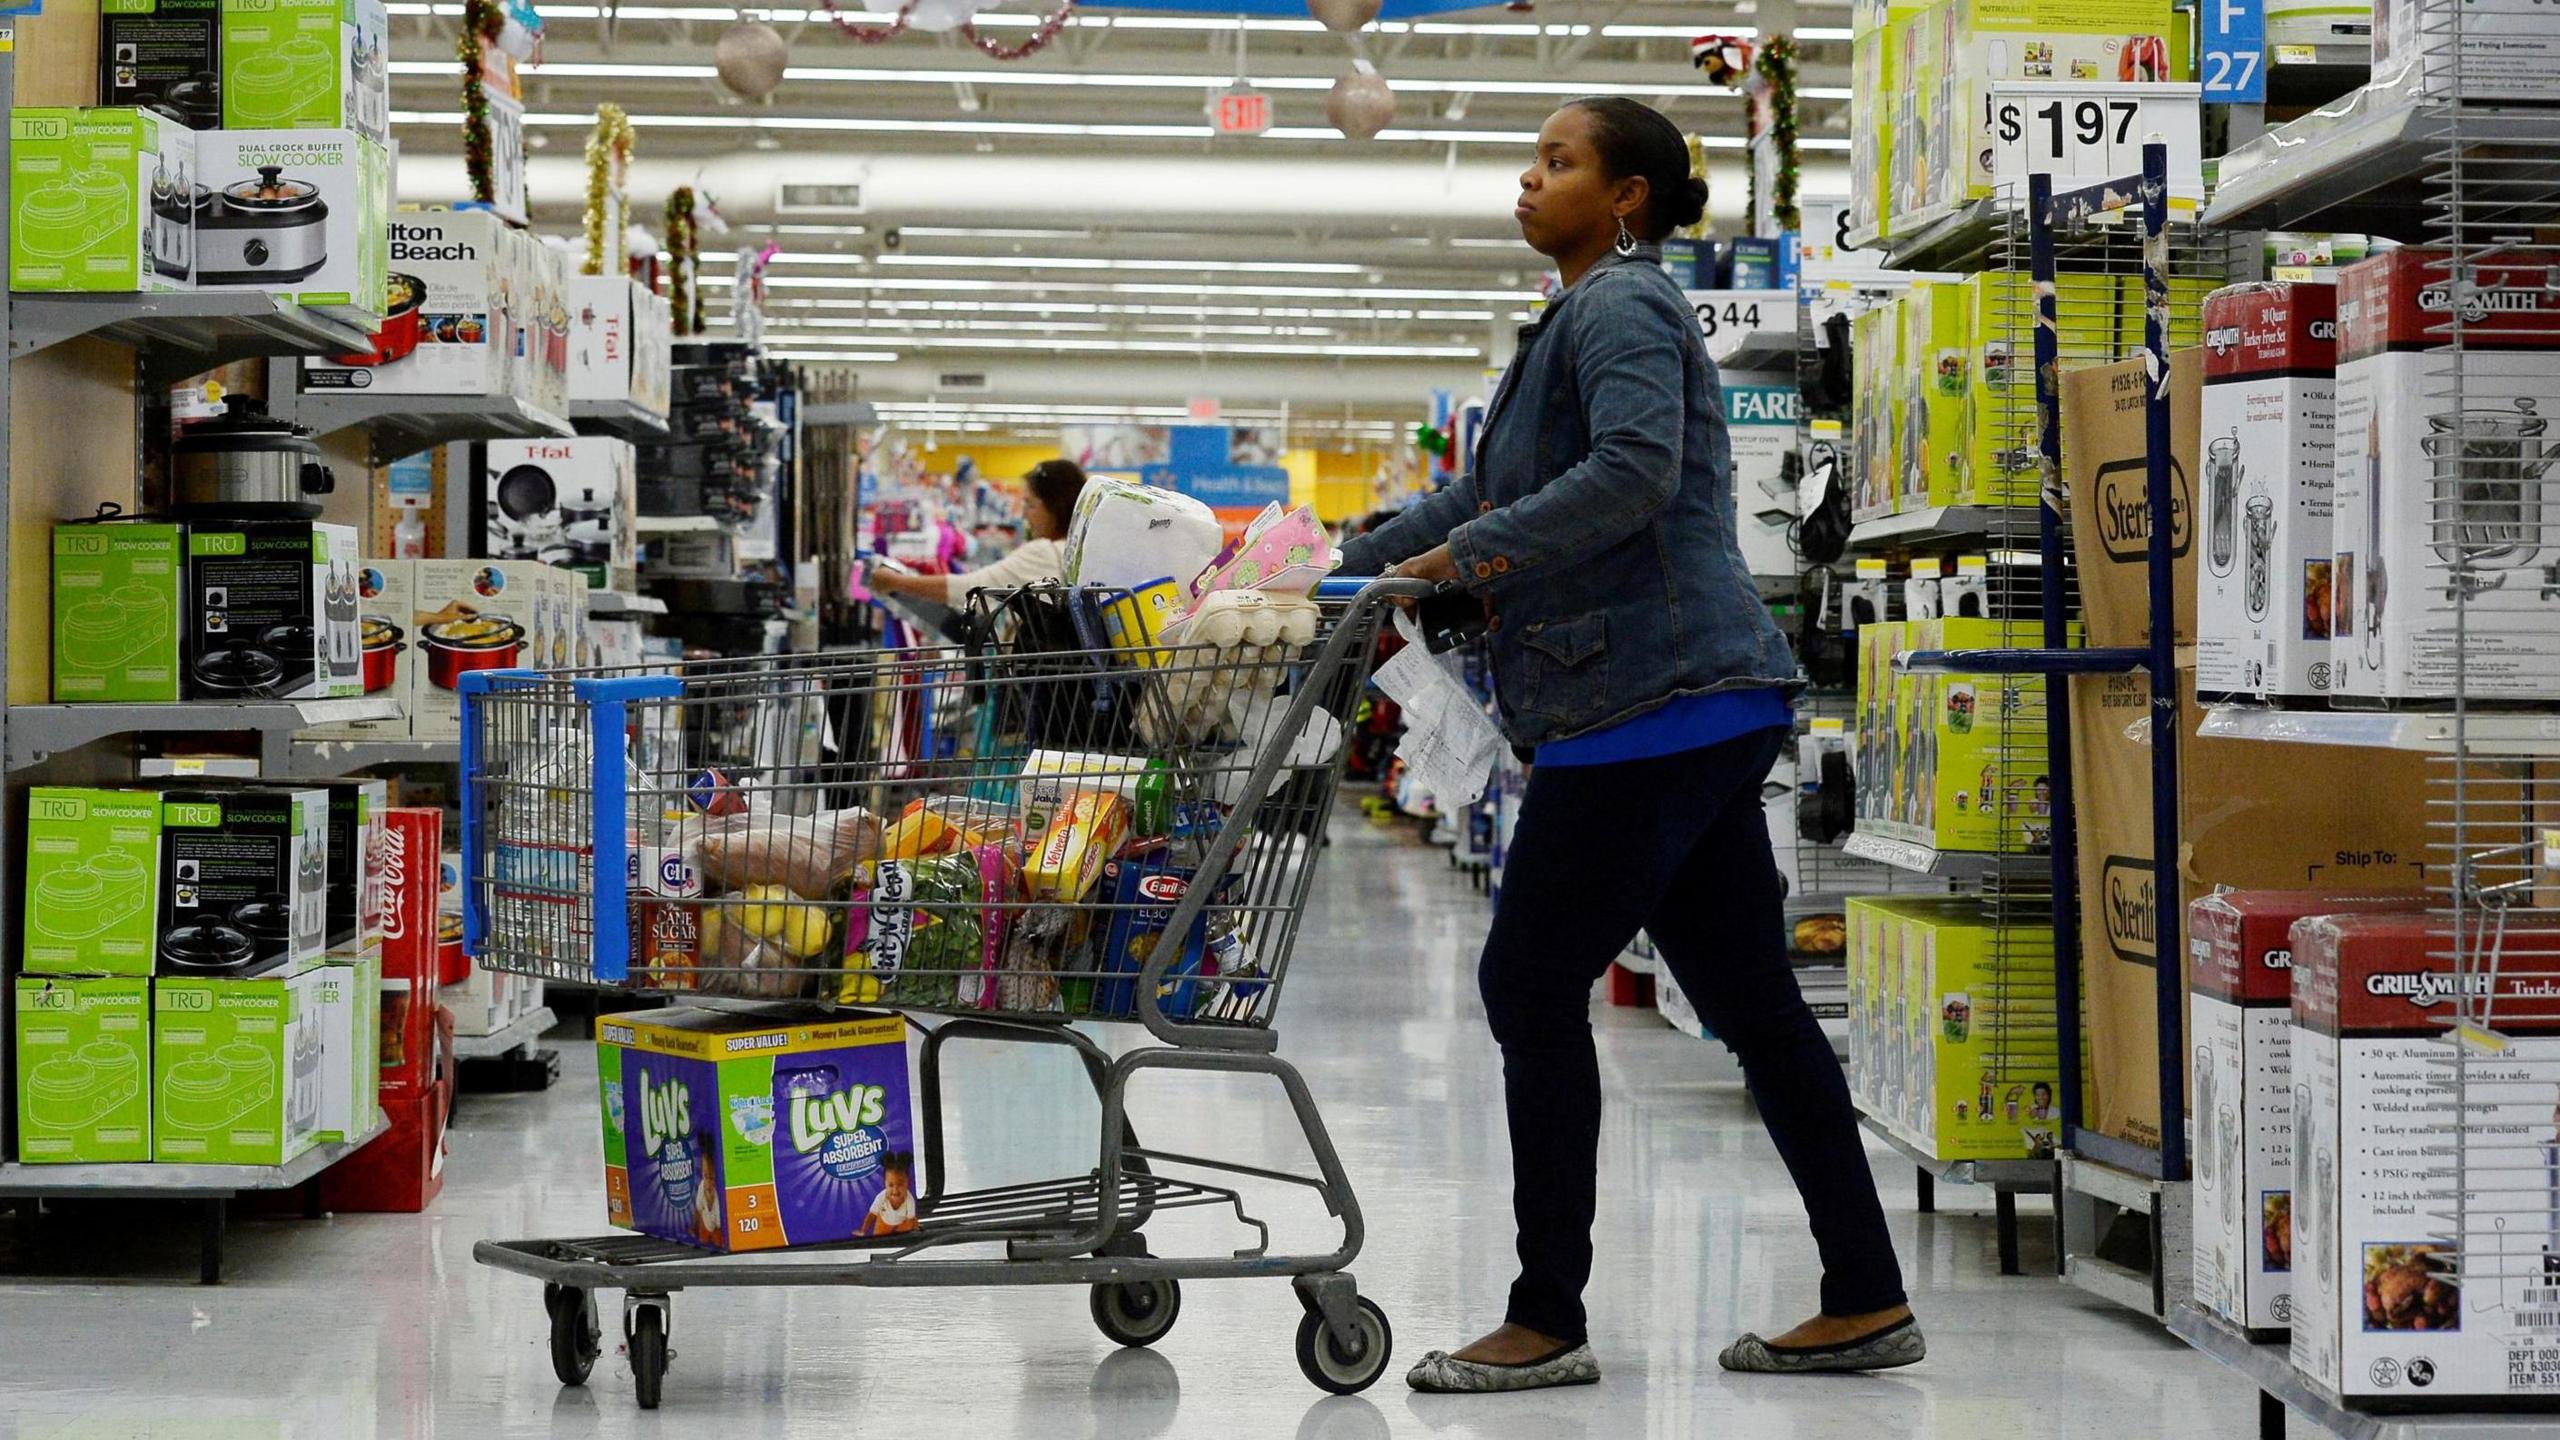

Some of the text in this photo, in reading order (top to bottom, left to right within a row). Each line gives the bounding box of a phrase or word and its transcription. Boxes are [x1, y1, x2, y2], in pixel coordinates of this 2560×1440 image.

[2204, 51, 2261, 92] 27
[1220, 96, 1263, 130] EXIT
[1999, 102, 2022, 146] $
[238, 143, 343, 152] DUAL CROCK BUFFET
[238, 152, 344, 167] SLOW COOKER
[390, 242, 476, 260] Beach
[2418, 289, 2538, 318] GRMITH
[525, 446, 573, 459] T-fal
[2106, 482, 2183, 542] Sterie
[1149, 518, 1173, 529] Bounty
[1034, 794, 1062, 803] Value
[92, 807, 153, 819] SLOW COOKER
[226, 814, 287, 824] SLOW COOKER
[1045, 824, 1070, 867] Velveeta
[2335, 851, 2398, 868] Ship To:
[383, 825, 405, 940] CocaCola
[873, 861, 903, 916] Clean
[1149, 878, 1187, 894] Barila
[656, 910, 693, 927] CANE
[1139, 907, 1172, 919] ELBO
[651, 923, 697, 940] SUGAR
[2366, 970, 2491, 1001] GRILLSMH
[80, 995, 142, 1006] SLOW COOKER
[218, 998, 280, 1009] SLOW COOKER
[2267, 1017, 2279, 1026] 30
[812, 1029, 838, 1041] Money
[839, 1027, 856, 1038] Back
[726, 1033, 788, 1051] SUPER VALUE!
[2269, 1038, 2291, 1046] Auto
[2269, 1050, 2291, 1059] cook
[2371, 1049, 2455, 1061] 30 qt. Aluminum
[2502, 1048, 2516, 1058] lid
[2372, 1070, 2423, 1081] Automatic
[2425, 1070, 2452, 1081] timer
[2457, 1070, 2497, 1082] rovides
[2507, 1069, 2531, 1081] safer
[2271, 1085, 2291, 1095] Turk
[2372, 1085, 2458, 1097] cooking experie
[640, 1067, 691, 1157] Luvs
[2270, 1105, 2291, 1114] Cast
[2372, 1103, 2408, 1113] Welded
[790, 1083, 886, 1155] Luvs
[2271, 1125, 2292, 1134] 5 PS
[2372, 1125, 2406, 1137] Turkey
[2486, 1124, 2530, 1134] included
[833, 1130, 866, 1148] SUPER
[821, 1139, 883, 1165] ABSORBENT
[2271, 1144, 2284, 1153] 12
[2372, 1147, 2394, 1157] Cast
[2396, 1147, 2418, 1157] iron
[2373, 1168, 2379, 1178] 5
[2382, 1168, 2409, 1178] PSIG
[614, 1176, 620, 1190] 3
[2373, 1190, 2476, 1201] 12 inch thermer
[748, 1195, 757, 1209] 3
[2372, 1205, 2416, 1215] included
[738, 1218, 759, 1233] 120
[2523, 1336, 2534, 1346] US
[2508, 1350, 2535, 1361] DEPT
[2509, 1361, 2525, 1373] PO
[2509, 1373, 2536, 1385] ITEM
